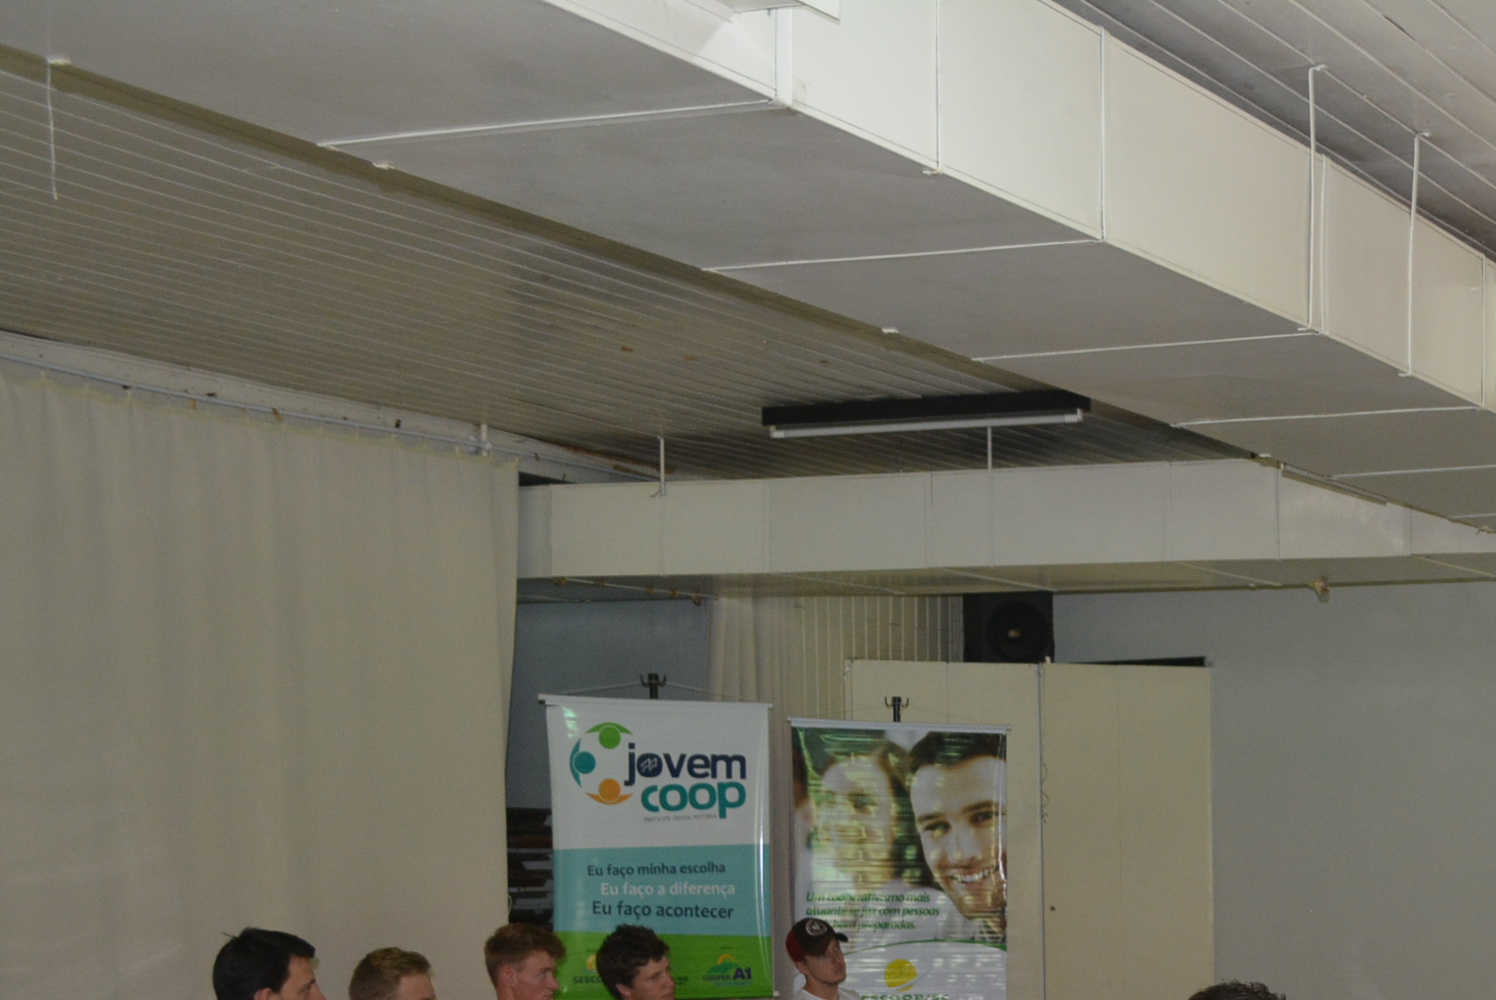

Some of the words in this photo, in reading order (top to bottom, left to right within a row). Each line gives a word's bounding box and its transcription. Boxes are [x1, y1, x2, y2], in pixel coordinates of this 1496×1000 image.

[623, 742, 747, 787] jovem
[640, 781, 747, 820] coop
[587, 864, 604, 877] Eu
[606, 863, 635, 879] faço
[637, 862, 677, 875] minha
[679, 861, 726, 875] escolha
[600, 882, 620, 896] Eu
[622, 881, 654, 899] faço
[657, 884, 667, 895] a
[669, 881, 736, 899] diferença
[906, 891, 931, 903] mais
[592, 900, 613, 916] Eu
[616, 901, 652, 920] faço
[655, 904, 735, 919] acontecer
[878, 907, 901, 916] com
[901, 907, 940, 918] pessoas
[732, 966, 753, 980] A1
